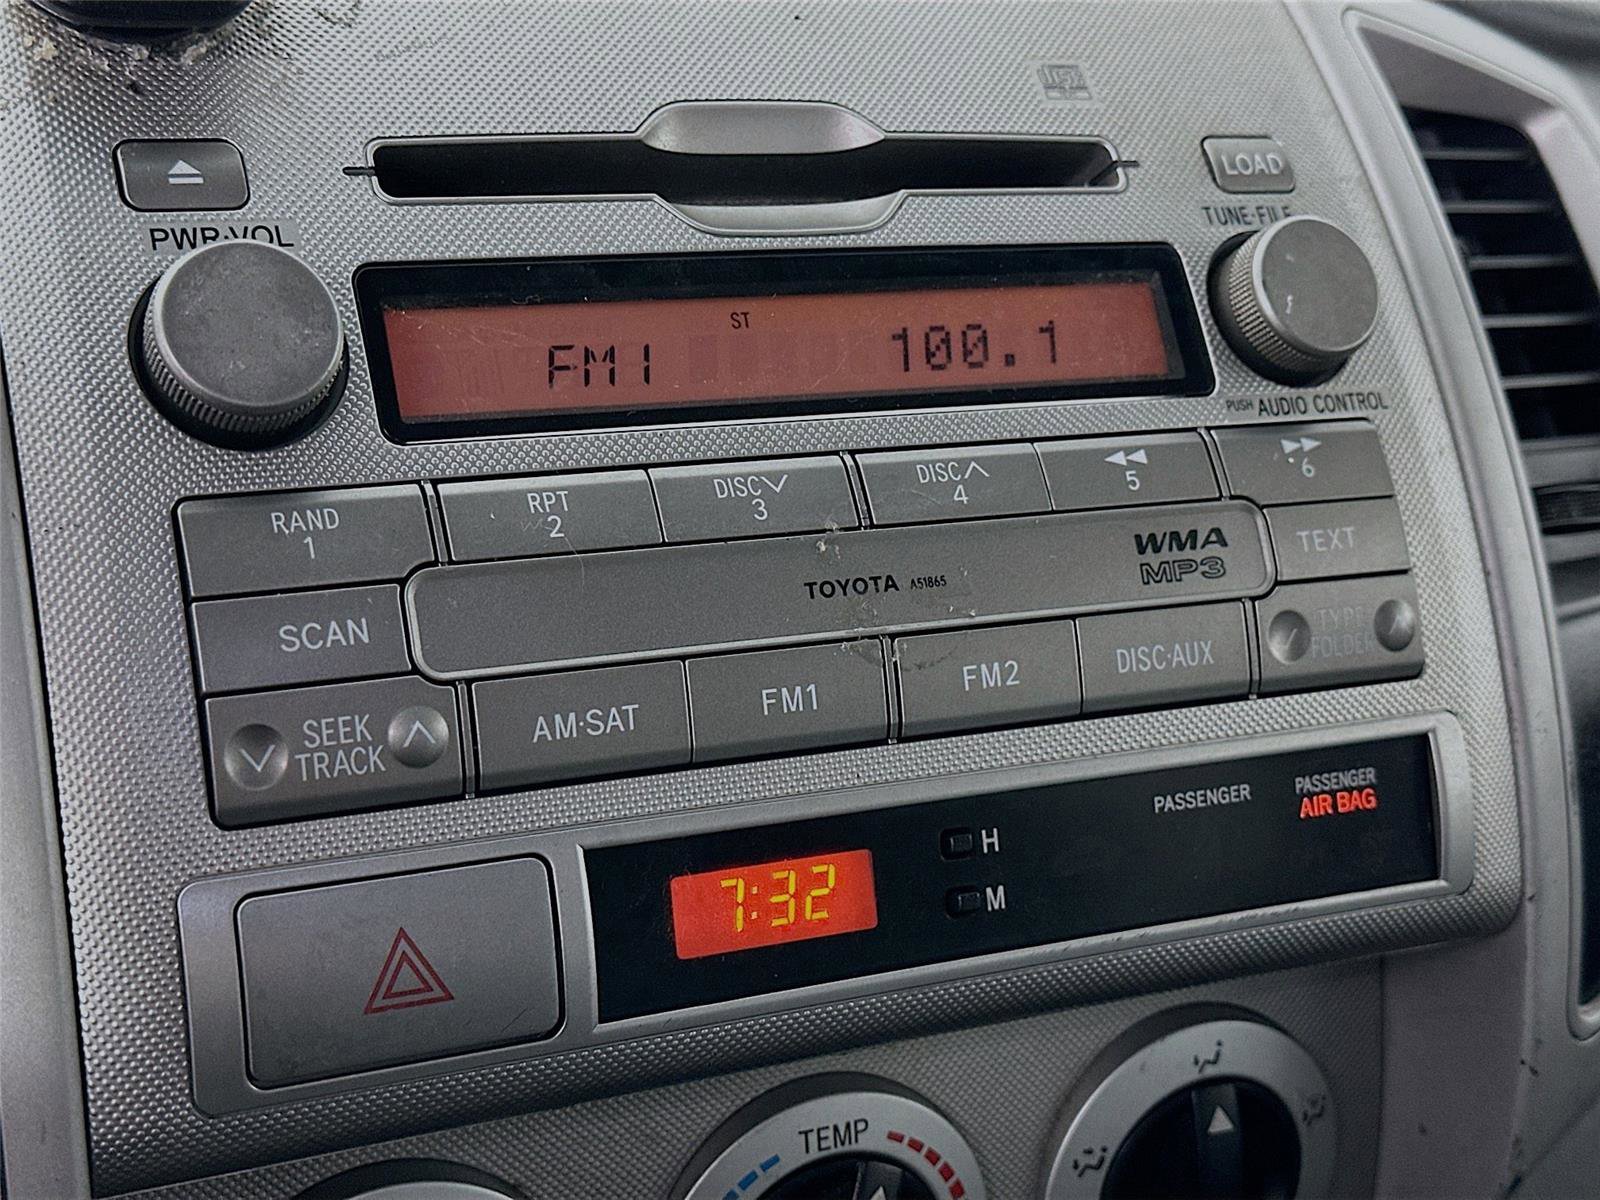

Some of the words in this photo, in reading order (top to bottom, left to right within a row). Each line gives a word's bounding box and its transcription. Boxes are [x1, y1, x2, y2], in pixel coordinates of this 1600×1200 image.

[1221, 153, 1283, 175] LOAD
[730, 312, 750, 329] ST
[892, 320, 1057, 372] 100.1
[1226, 400, 1254, 412] PUSH
[1258, 396, 1307, 417] AUDIO
[1313, 392, 1389, 413] CONTROL
[913, 462, 962, 483] DISC
[1302, 456, 1315, 478] 6
[713, 475, 762, 499] DISC
[1125, 470, 1141, 491] 5
[527, 490, 569, 514] RPT
[953, 484, 969, 505] 4
[270, 507, 340, 535] RAND
[751, 498, 769, 521] 3
[547, 514, 565, 538] 2
[1297, 526, 1357, 552] TEXT
[303, 535, 315, 560] 1
[1134, 527, 1229, 555] WMA
[1139, 556, 1227, 586] MP3
[804, 574, 900, 600] TOYOTA
[910, 575, 947, 591] A51865
[279, 616, 370, 652] SCAN
[962, 661, 1021, 692] FM2
[761, 684, 820, 716] FM1
[302, 714, 373, 749] SEEK
[294, 745, 387, 782] TRACK
[1295, 767, 1377, 794] PASSENGER
[1153, 784, 1252, 814] PASSENGER
[1300, 794, 1333, 819] AIR
[1336, 788, 1378, 813] BAG
[981, 828, 1000, 853] H
[719, 863, 836, 933] 7:32
[985, 885, 1006, 912] M
[798, 1118, 869, 1154] TEMP
